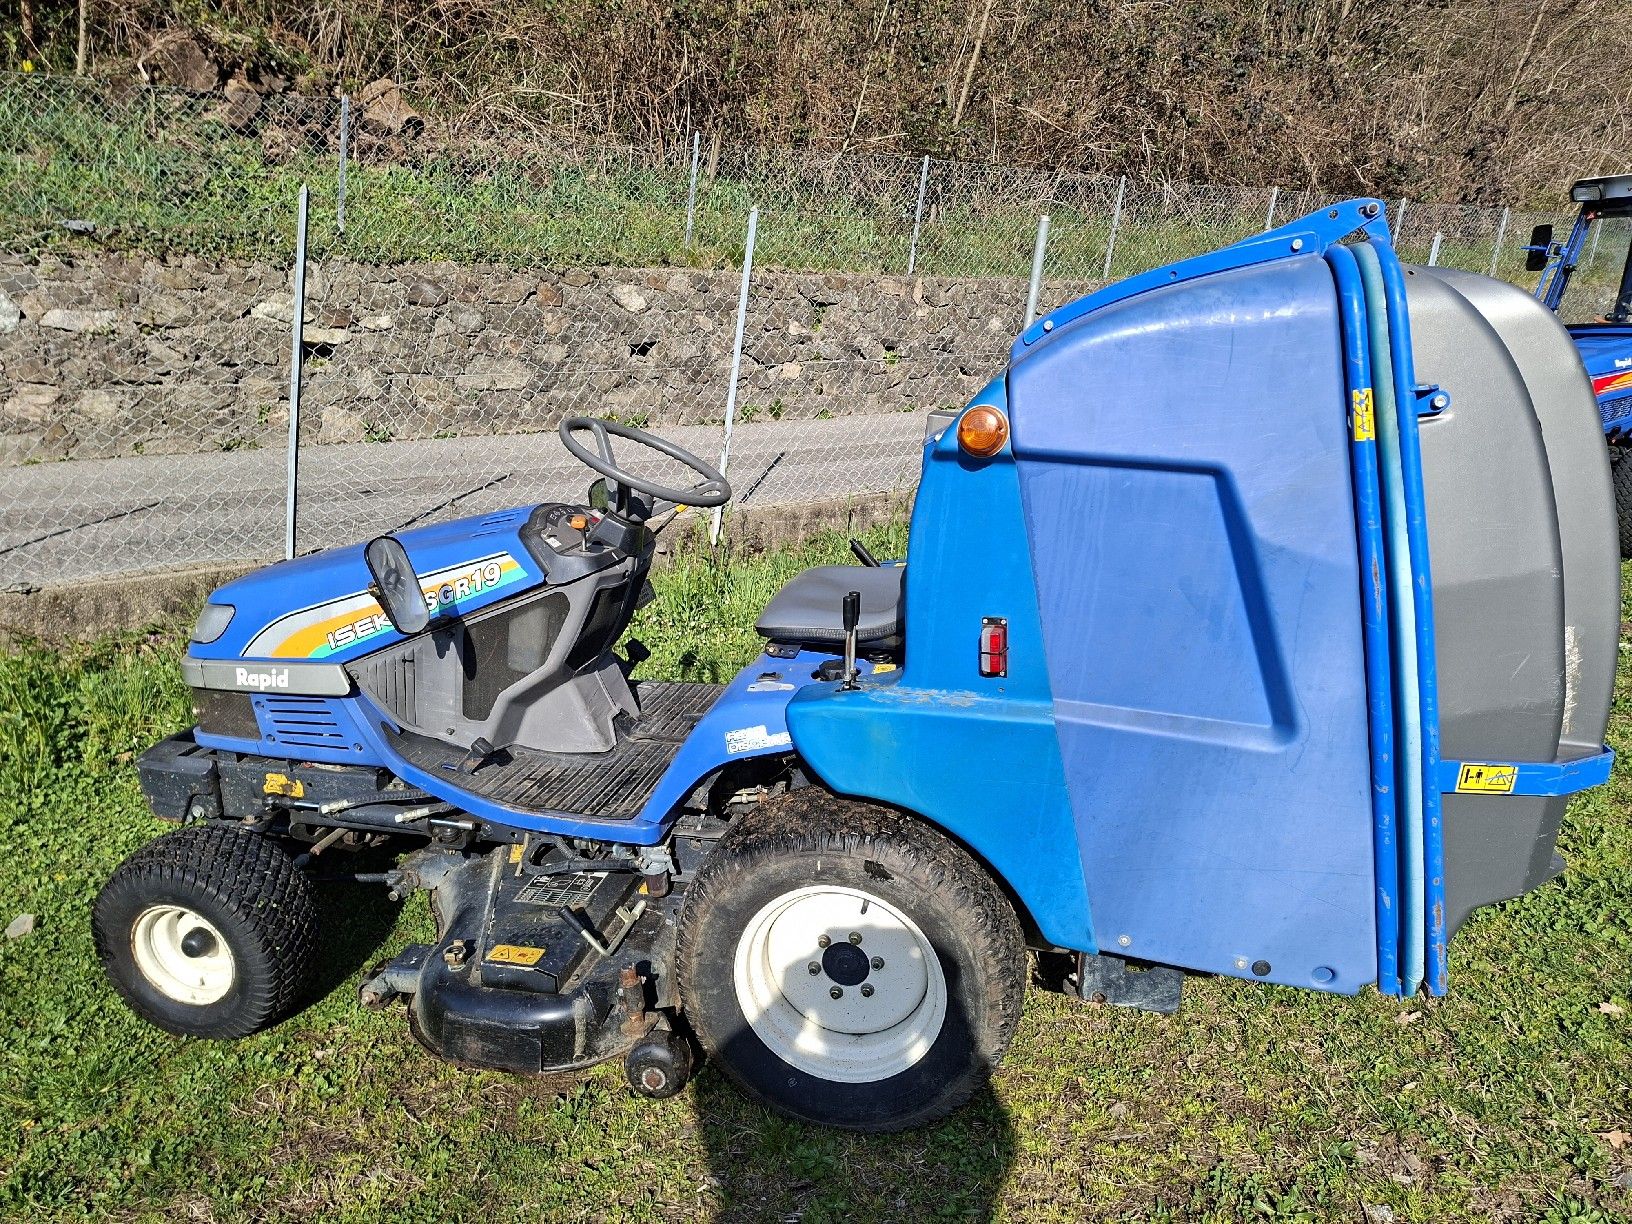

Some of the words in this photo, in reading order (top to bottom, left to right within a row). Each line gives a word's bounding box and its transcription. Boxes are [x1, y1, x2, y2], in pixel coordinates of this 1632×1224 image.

[326, 612, 394, 650] ISEK
[424, 563, 502, 611] SGR19
[235, 668, 289, 690] Rapid
